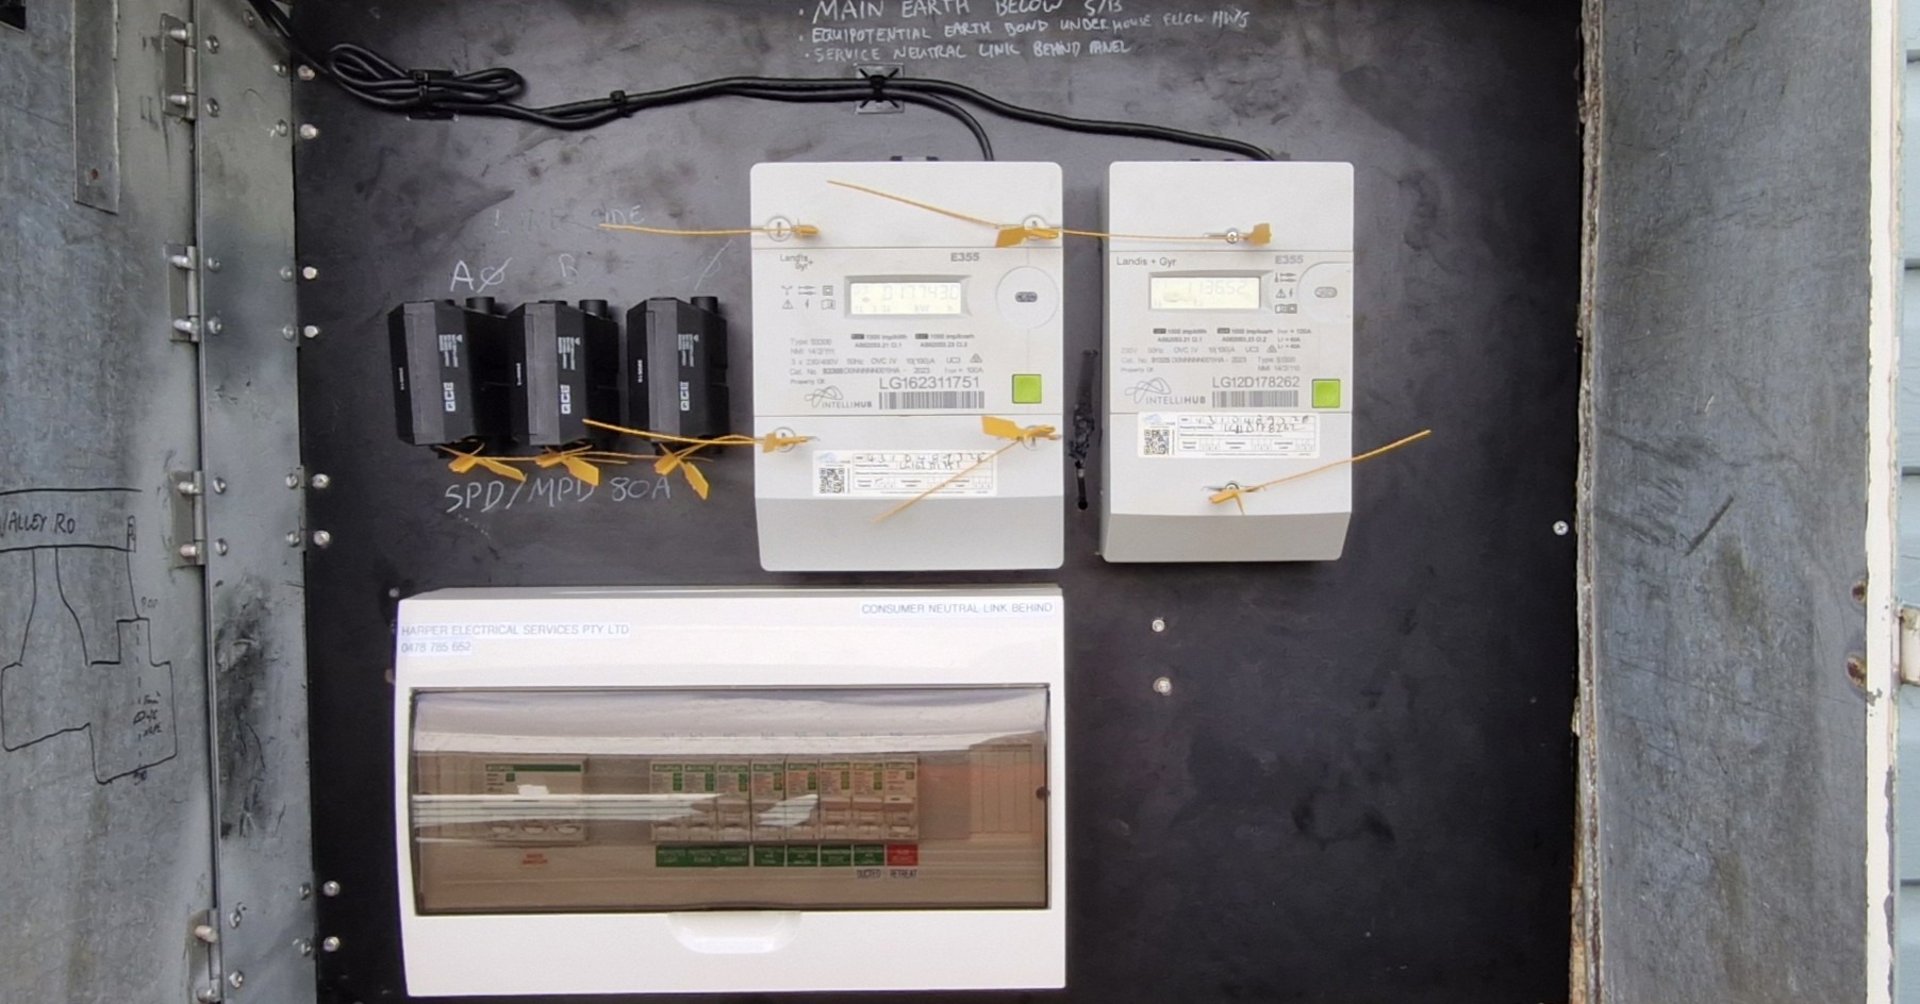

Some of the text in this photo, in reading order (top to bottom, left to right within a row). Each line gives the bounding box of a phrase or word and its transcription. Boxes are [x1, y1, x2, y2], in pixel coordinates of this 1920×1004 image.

[812, 0, 884, 24] MAIN
[902, 0, 970, 18] EARTH
[996, 0, 1062, 16] BELOW
[812, 27, 931, 43] EQUIPOTENTIAL
[944, 22, 992, 37] EARTH
[1005, 21, 1048, 37] BOND
[814, 48, 880, 62] SERVICE
[893, 44, 967, 60] NEUTRAL
[979, 43, 1021, 58] LINK
[1032, 40, 1081, 57] BEHIND
[950, 252, 980, 262] E355
[1116, 257, 1149, 266] Landis
[1159, 257, 1176, 267] Gyr
[1275, 255, 1304, 264] E355
[879, 376, 979, 390] LG162311751
[1212, 376, 1300, 388] LG12D178262
[1146, 396, 1206, 405] INTELLIHUB
[862, 602, 1053, 614] CONSUMER NEUTRAL LINK BEHIND
[401, 624, 629, 636] HARPER ELECTRICAL SERVICES PTY LTD
